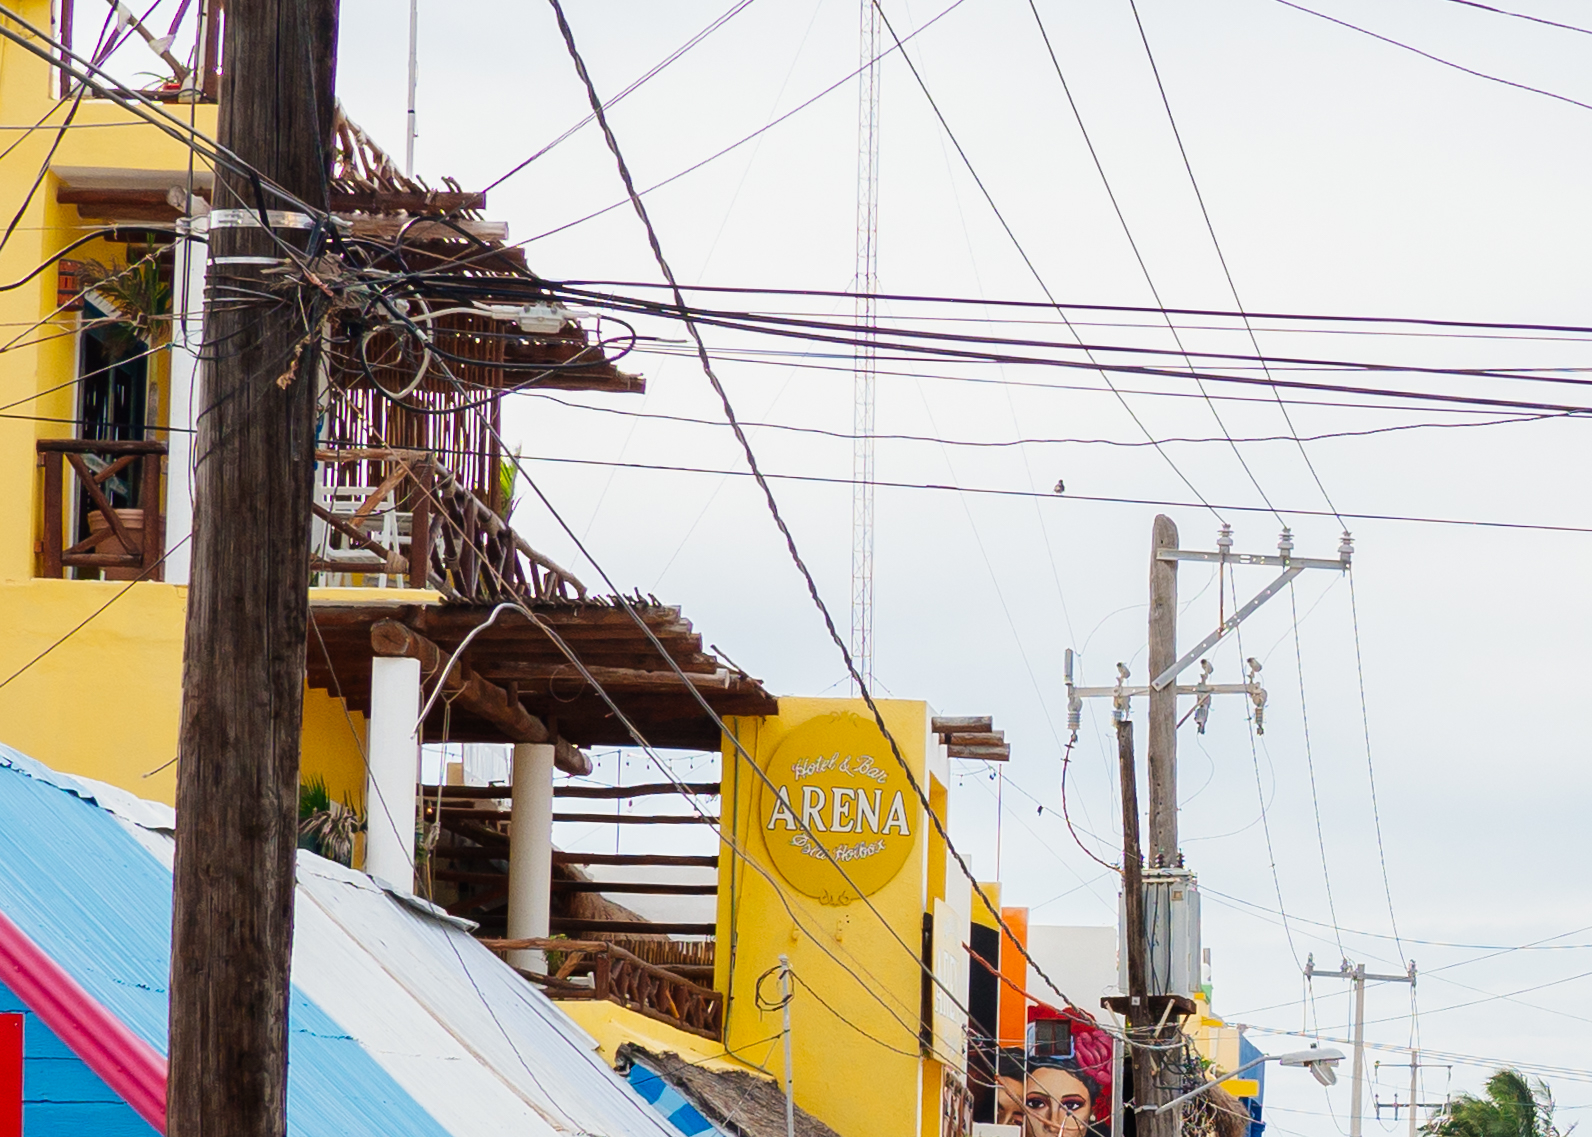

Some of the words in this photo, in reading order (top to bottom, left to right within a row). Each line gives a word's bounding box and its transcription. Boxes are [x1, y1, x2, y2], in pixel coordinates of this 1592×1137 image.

[791, 752, 839, 780] Hotel
[839, 755, 855, 777] &
[854, 755, 888, 783] Bar
[766, 784, 911, 836] ARENA
